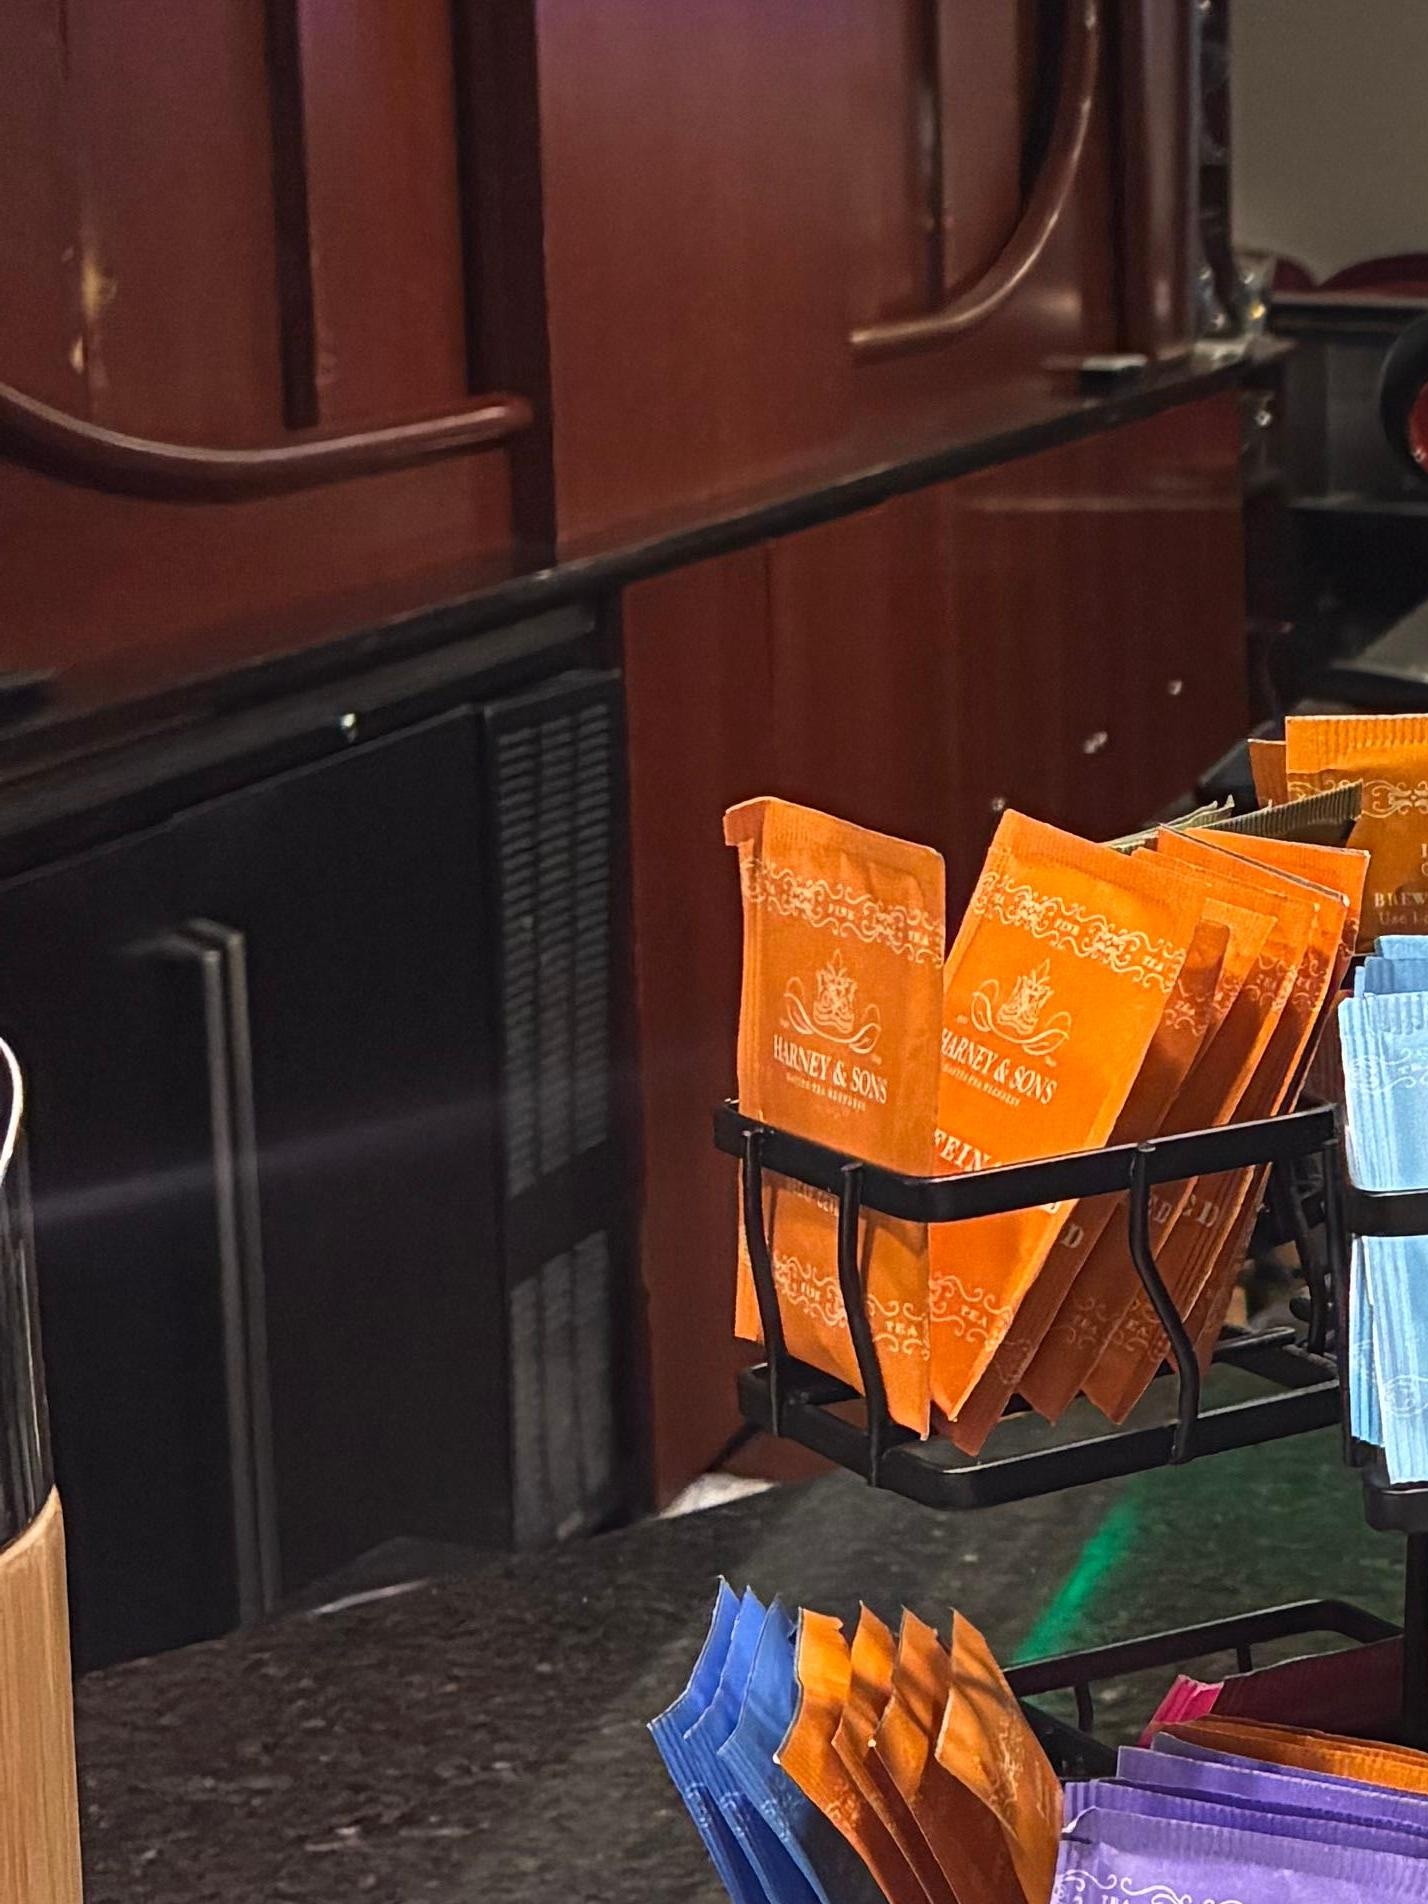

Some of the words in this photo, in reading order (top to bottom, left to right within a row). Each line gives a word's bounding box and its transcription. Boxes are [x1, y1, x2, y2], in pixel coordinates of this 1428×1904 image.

[773, 1033, 832, 1082] HARNEY
[833, 1059, 848, 1088] &
[851, 1066, 888, 1105] SONS
[994, 1058, 1012, 1084] &
[1009, 1064, 1058, 1106] SONS
[885, 1320, 918, 1337] TEA
